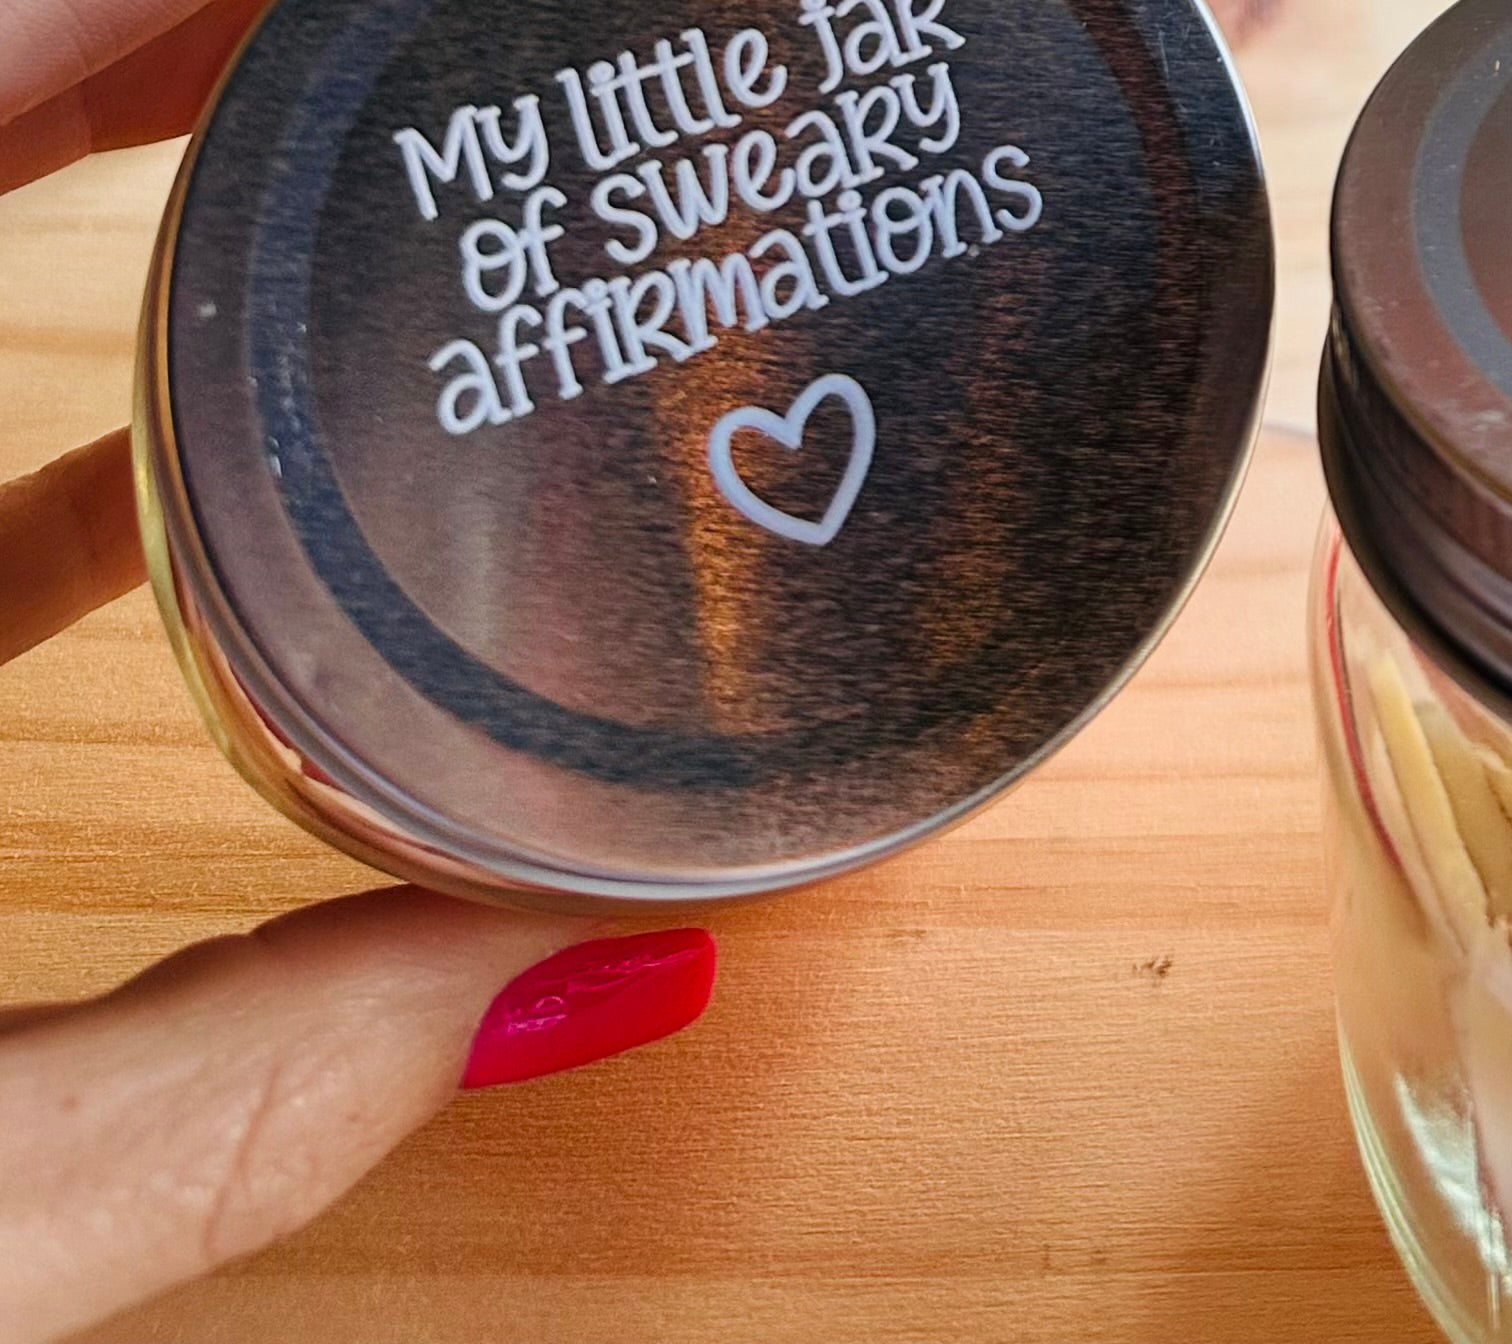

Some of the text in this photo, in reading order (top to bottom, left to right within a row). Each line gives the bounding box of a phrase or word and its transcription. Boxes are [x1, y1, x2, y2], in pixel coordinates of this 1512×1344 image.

[393, 93, 549, 220] My
[555, 25, 789, 171] little
[457, 185, 568, 311] of
